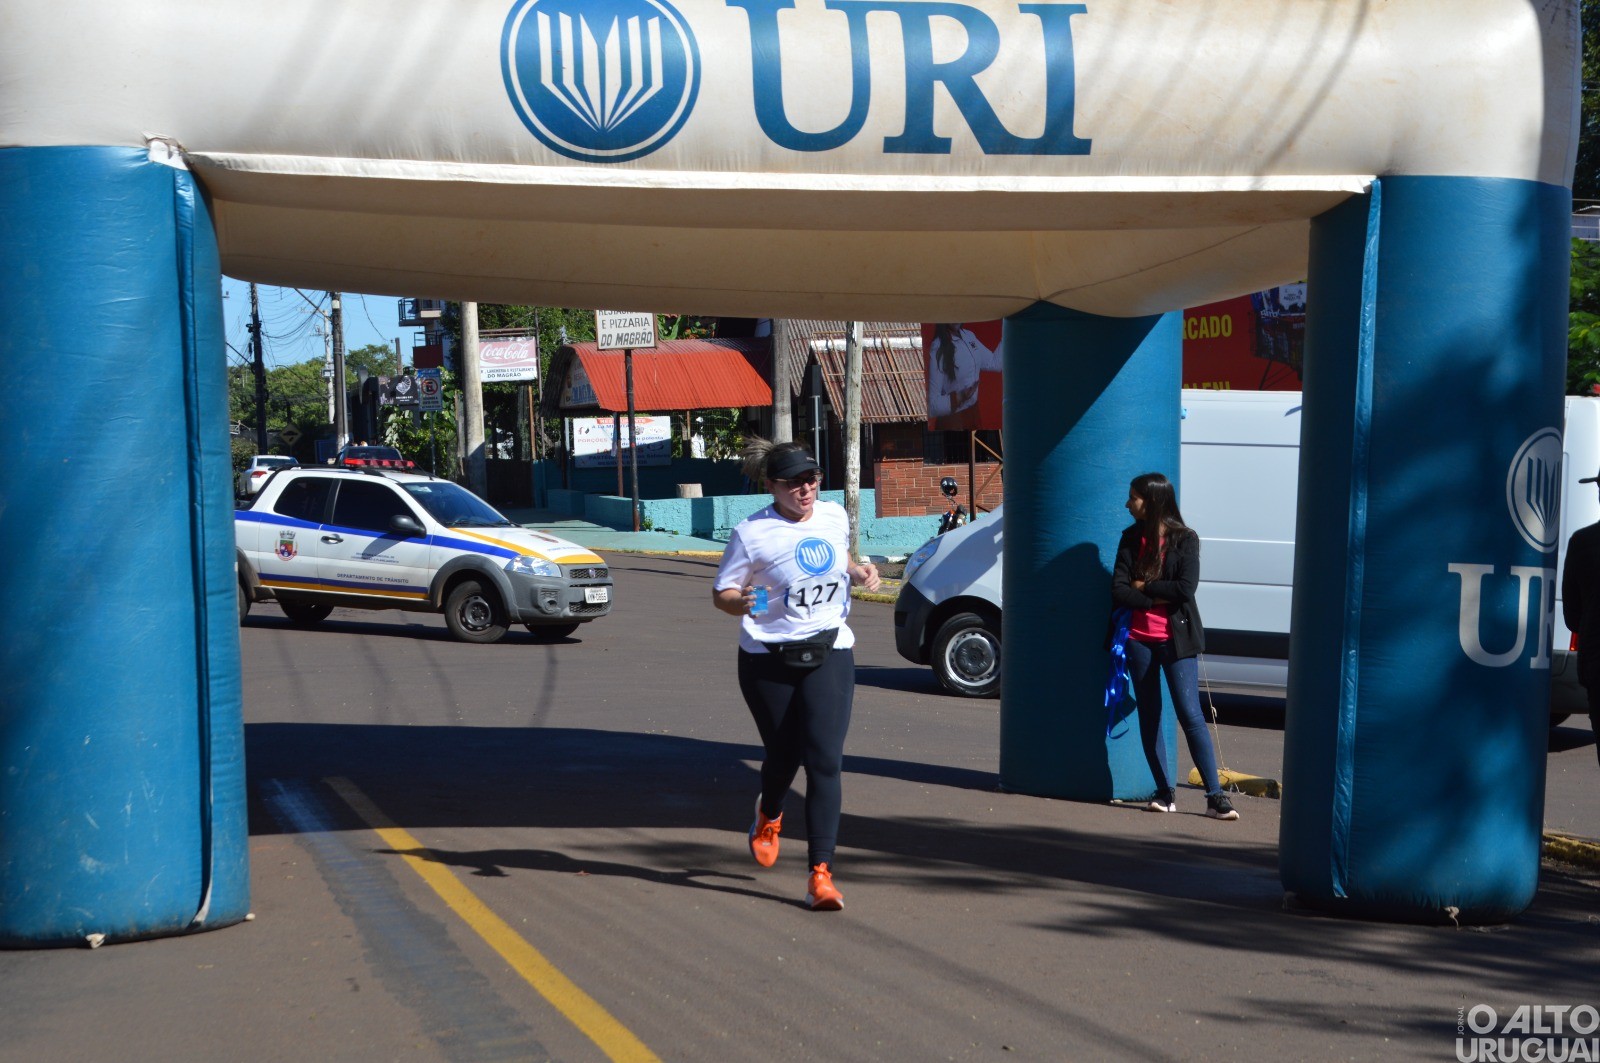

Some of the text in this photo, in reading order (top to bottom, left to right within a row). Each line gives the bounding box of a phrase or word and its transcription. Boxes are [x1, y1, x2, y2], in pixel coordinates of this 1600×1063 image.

[725, 0, 1092, 155] URI
[601, 317, 651, 329] E PIZZARIA
[600, 328, 653, 347] DO MAGRÃO
[480, 341, 531, 360] Coca-Cola
[336, 573, 376, 581] DEPARTAMENTO
[795, 582, 839, 607] 127
